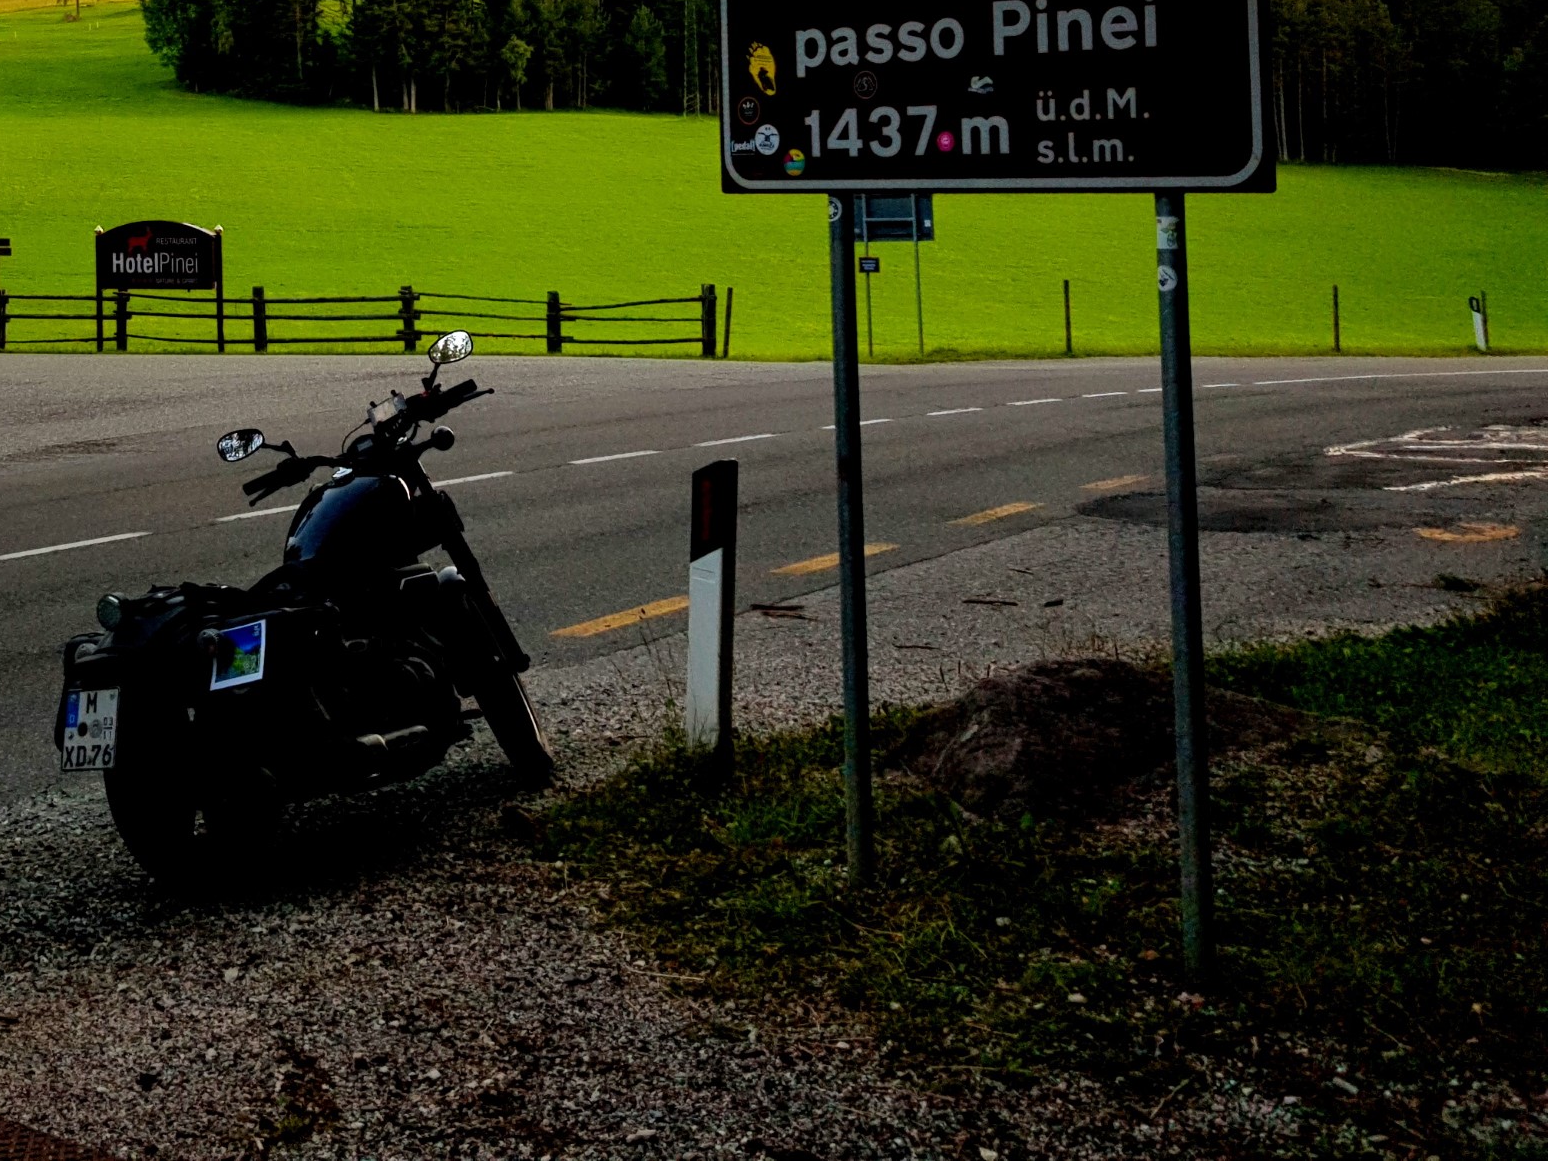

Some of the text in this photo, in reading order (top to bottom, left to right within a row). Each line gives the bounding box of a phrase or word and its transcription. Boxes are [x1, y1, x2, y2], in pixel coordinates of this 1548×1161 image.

[796, 18, 965, 78] passo
[1037, 87, 1150, 123] ü.d.M.
[804, 105, 1010, 158] 1437 m
[1037, 132, 1135, 164] s.l.m.
[155, 237, 197, 245] RESTAURANT
[86, 692, 97, 713] M
